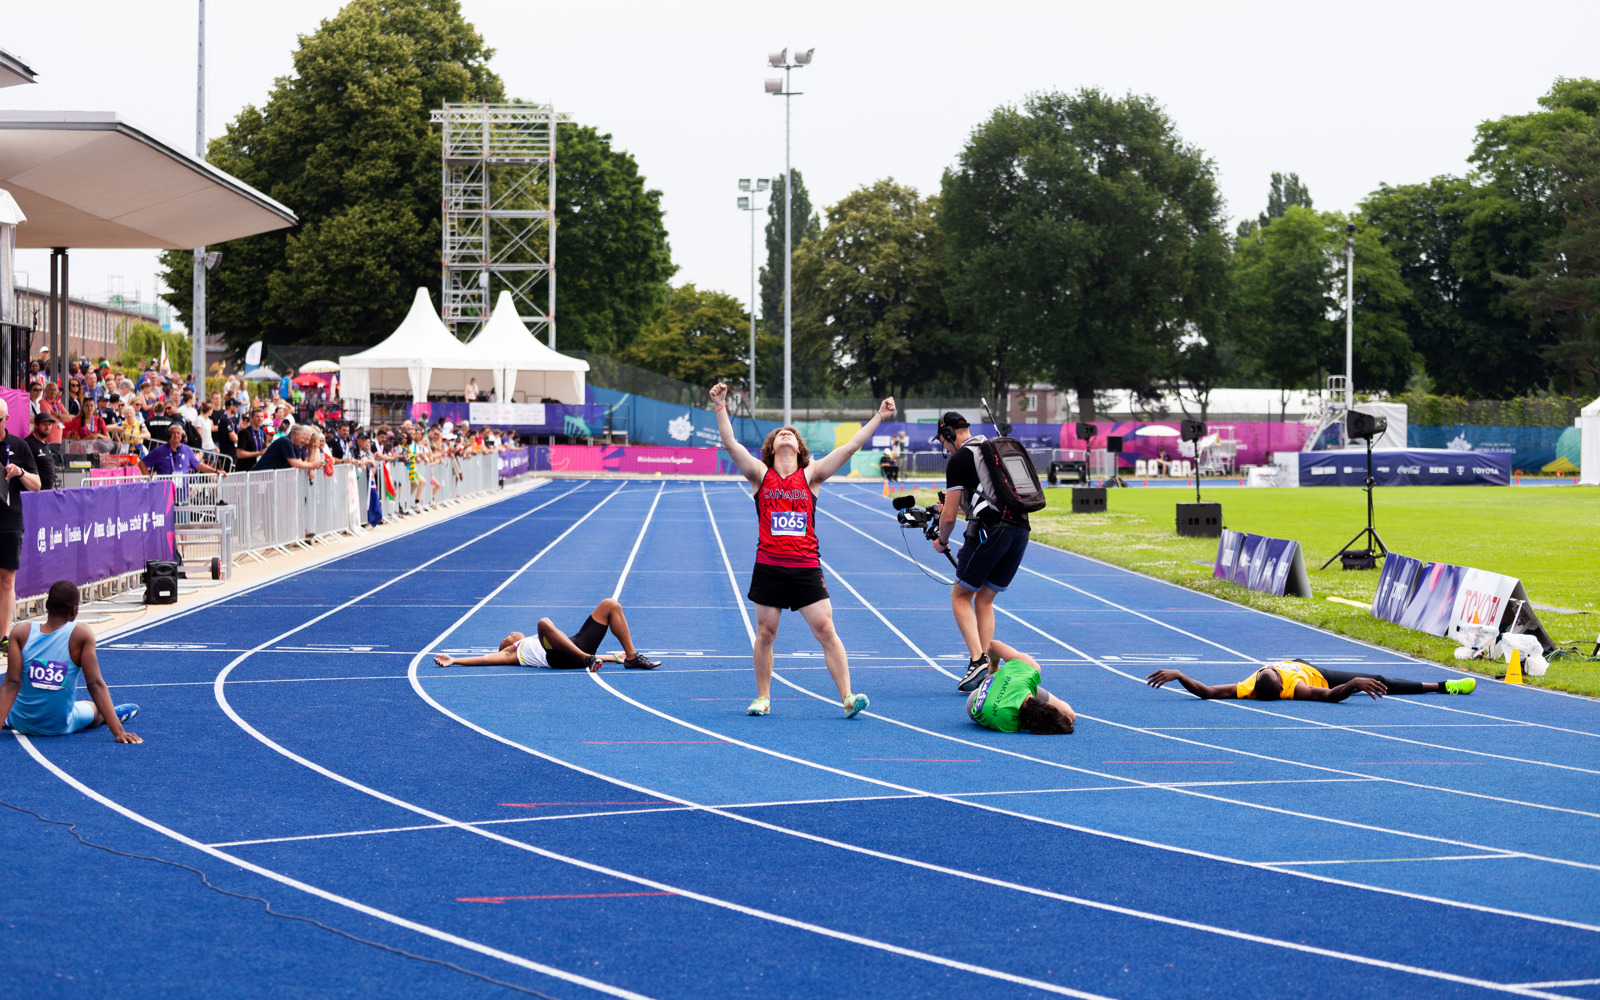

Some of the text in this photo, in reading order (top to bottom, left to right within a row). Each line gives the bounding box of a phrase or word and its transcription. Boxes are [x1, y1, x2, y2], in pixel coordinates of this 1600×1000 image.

[1429, 465, 1449, 474] REWE
[1472, 467, 1499, 475] TOYOTA
[762, 488, 808, 500] CANADA
[773, 516, 804, 529] 1065
[1460, 589, 1501, 626] TOYOTA
[29, 665, 64, 683] 1036
[992, 675, 1012, 717] PAKISTAN
